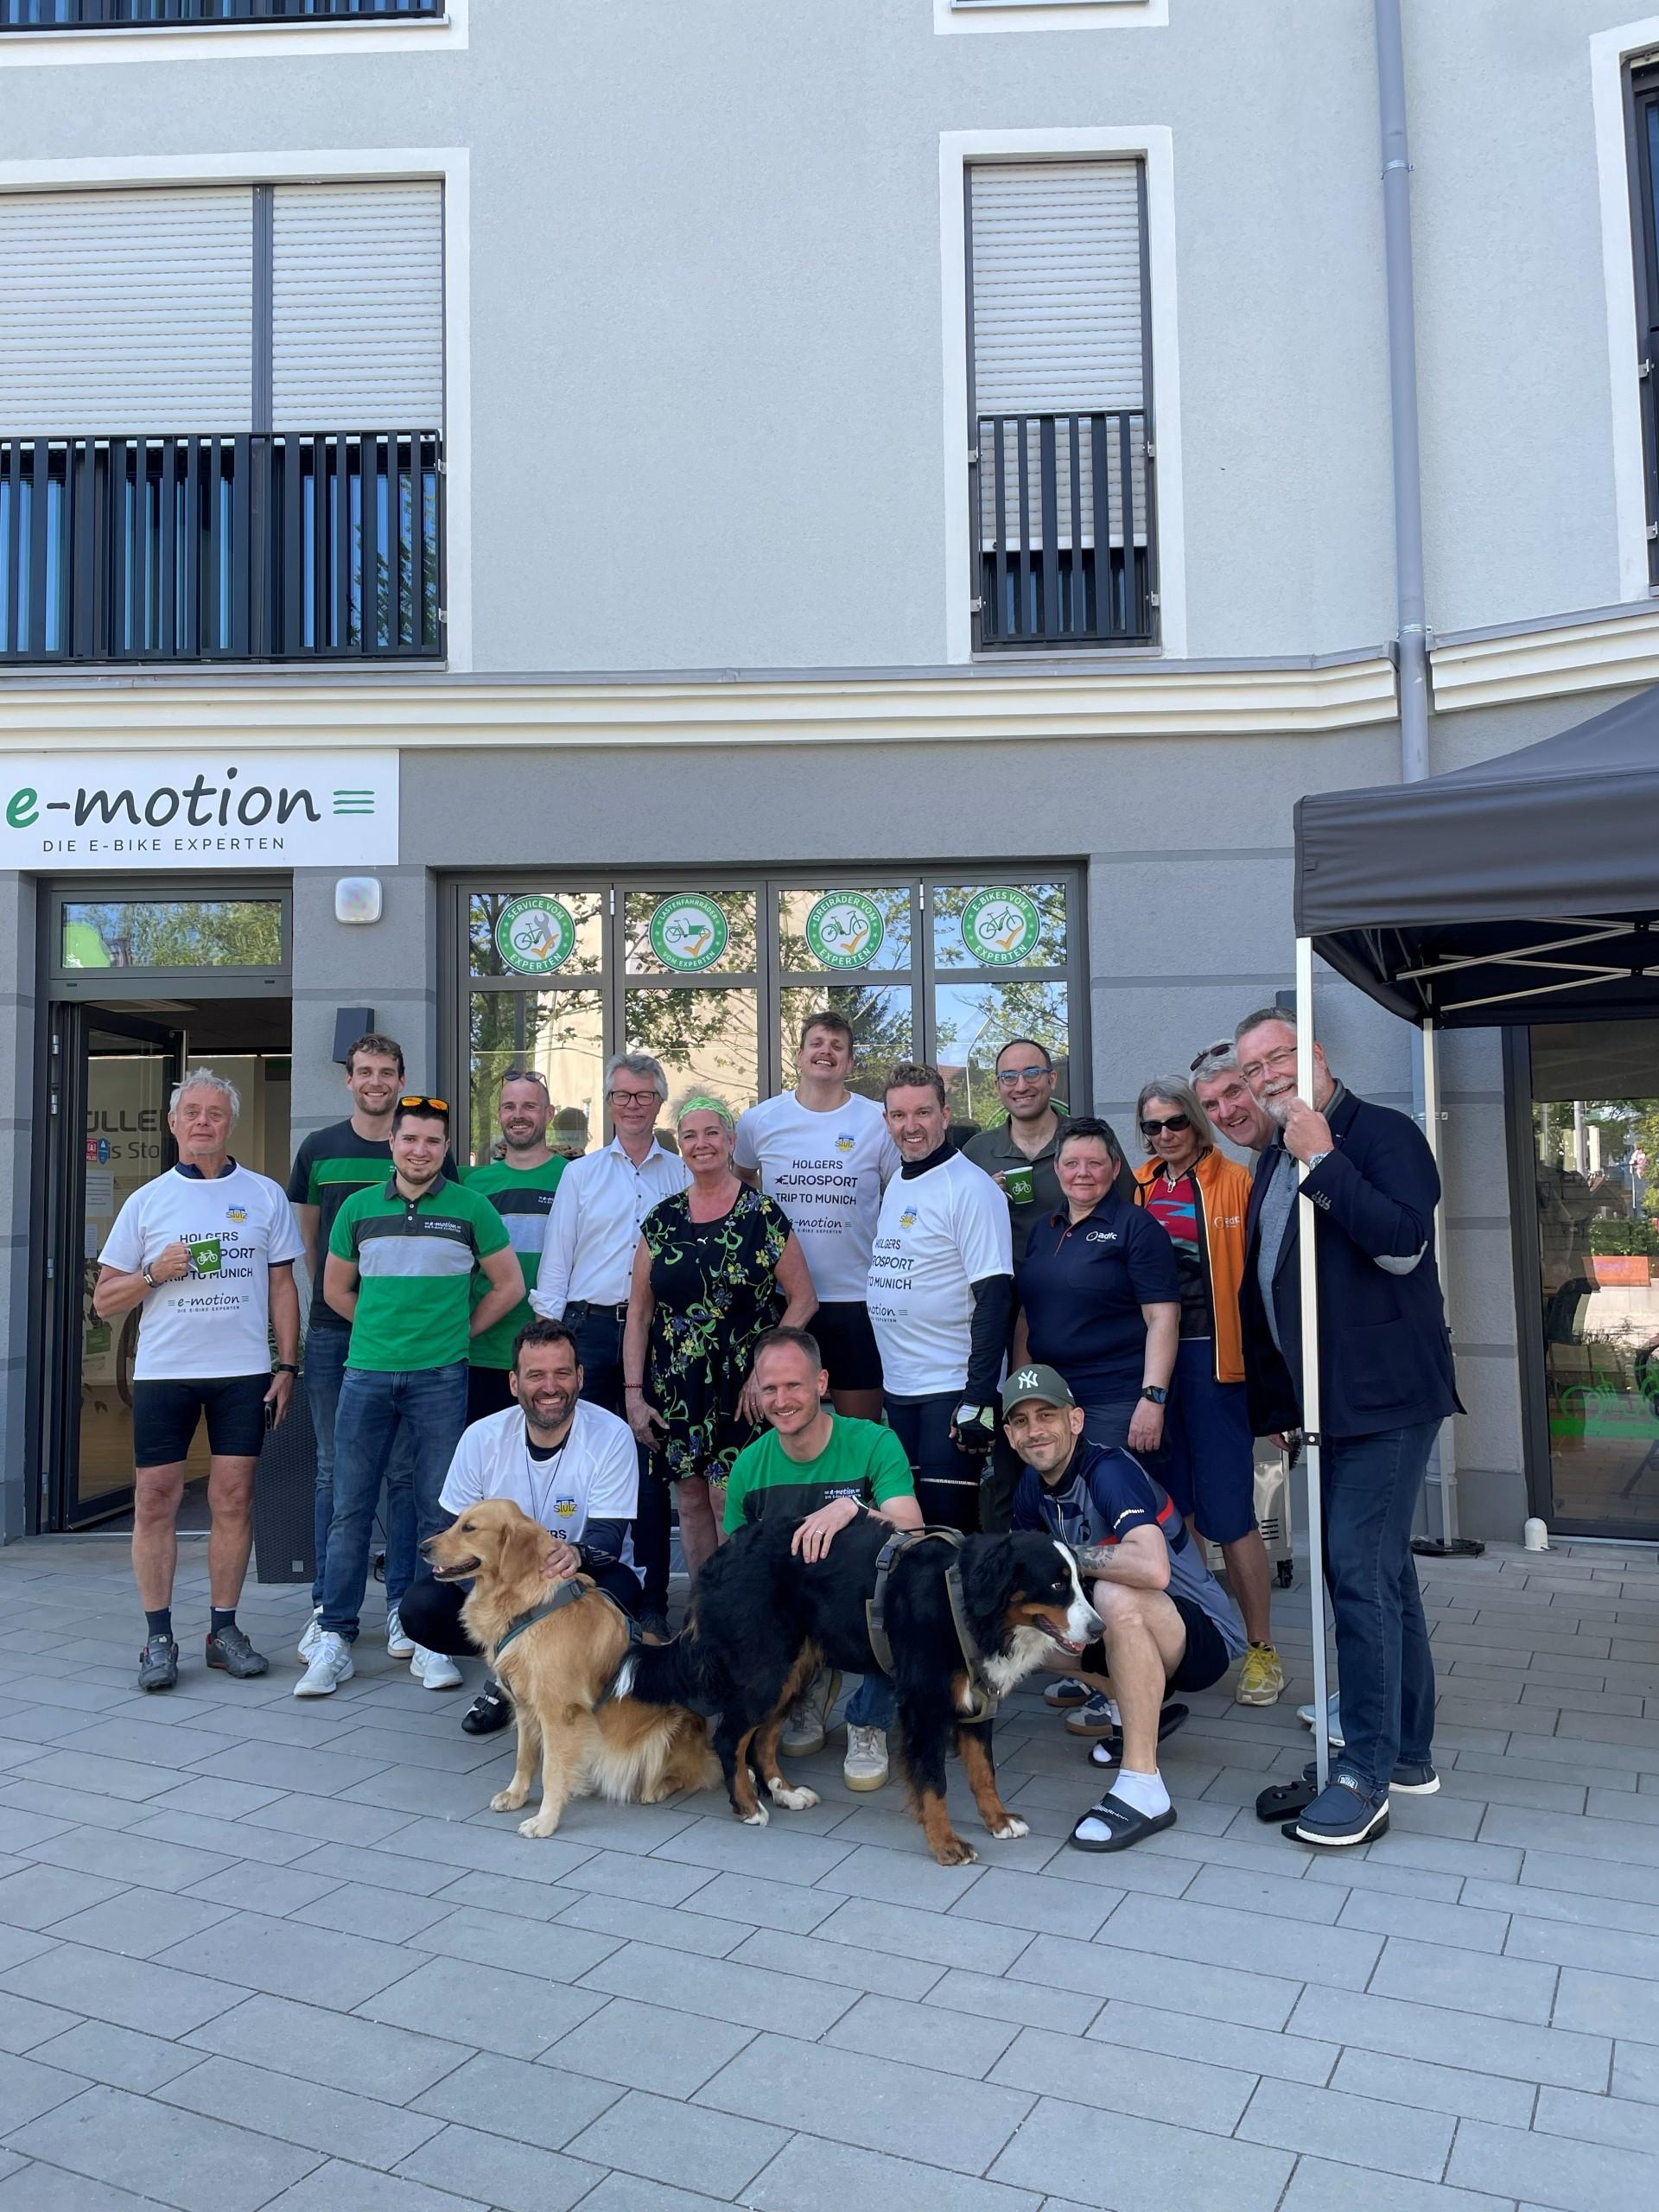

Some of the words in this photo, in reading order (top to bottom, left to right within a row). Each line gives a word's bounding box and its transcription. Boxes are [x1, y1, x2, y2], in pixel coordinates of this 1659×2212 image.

[6, 767, 321, 829] e-motion
[43, 841, 76, 852] DIE
[89, 839, 162, 851] E-BIKE
[175, 837, 284, 850] EXPERTEN
[507, 899, 544, 920] SERVICE
[546, 902, 565, 920] VOM
[813, 895, 860, 921] DREIRÄDER
[861, 901, 877, 921] VOM
[971, 892, 1007, 912] E-BIKES
[1009, 893, 1028, 911] VOM
[509, 952, 563, 970] EXPERTEN
[662, 951, 677, 964] VOM
[678, 950, 715, 968] EXPERTEN
[819, 948, 871, 965] EXPERTEN
[975, 944, 1027, 962] EXPERTEN
[792, 1160, 843, 1169] HOLGERS
[775, 1174, 858, 1187] EUROSPORT
[775, 1192, 798, 1202] TRIP
[799, 1193, 812, 1203] TO
[815, 1194, 856, 1205] MUNICH
[210, 1268, 253, 1280] MUNICH
[874, 1277, 912, 1290] MUNICH
[177, 1293, 240, 1307] e-motion
